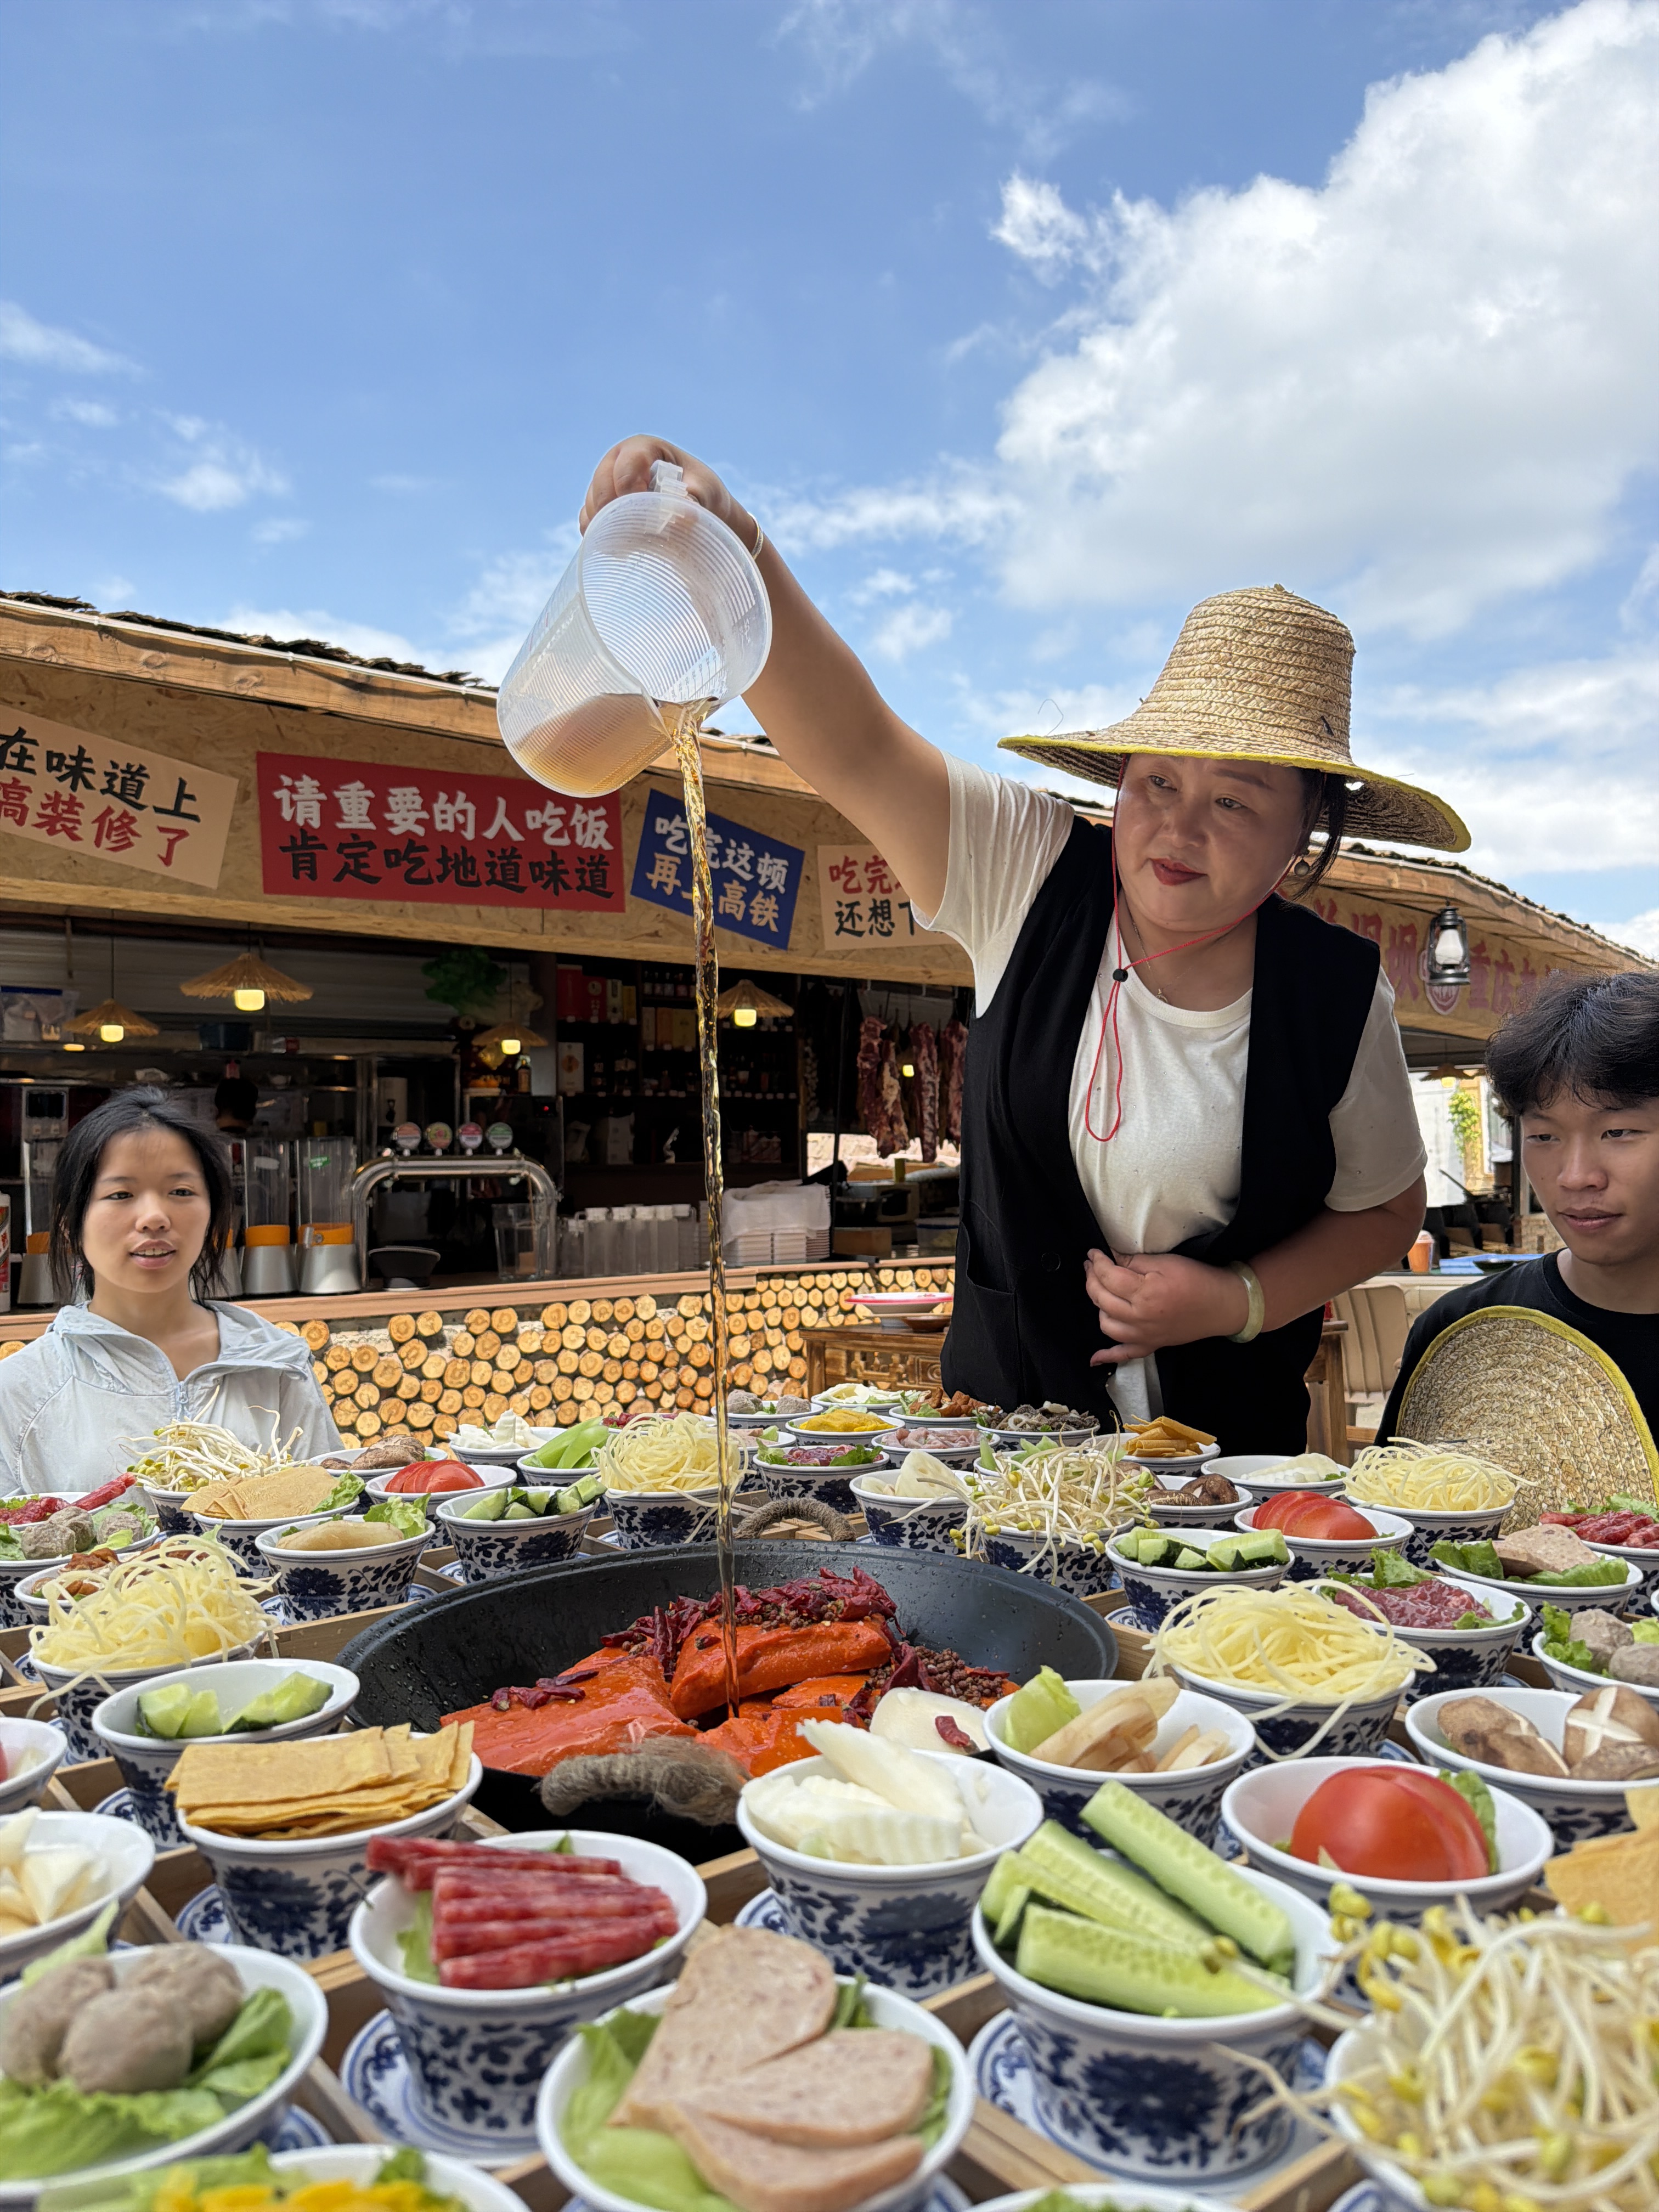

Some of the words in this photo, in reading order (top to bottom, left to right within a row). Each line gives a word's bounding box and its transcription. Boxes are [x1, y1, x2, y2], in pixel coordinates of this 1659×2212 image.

[0, 726, 201, 822] 在味道上
[274, 774, 614, 850] 请重要的人吃饭
[279, 828, 614, 899] 肯定吃地道味道
[646, 852, 778, 932] 再高铁
[829, 855, 901, 894] 吃完
